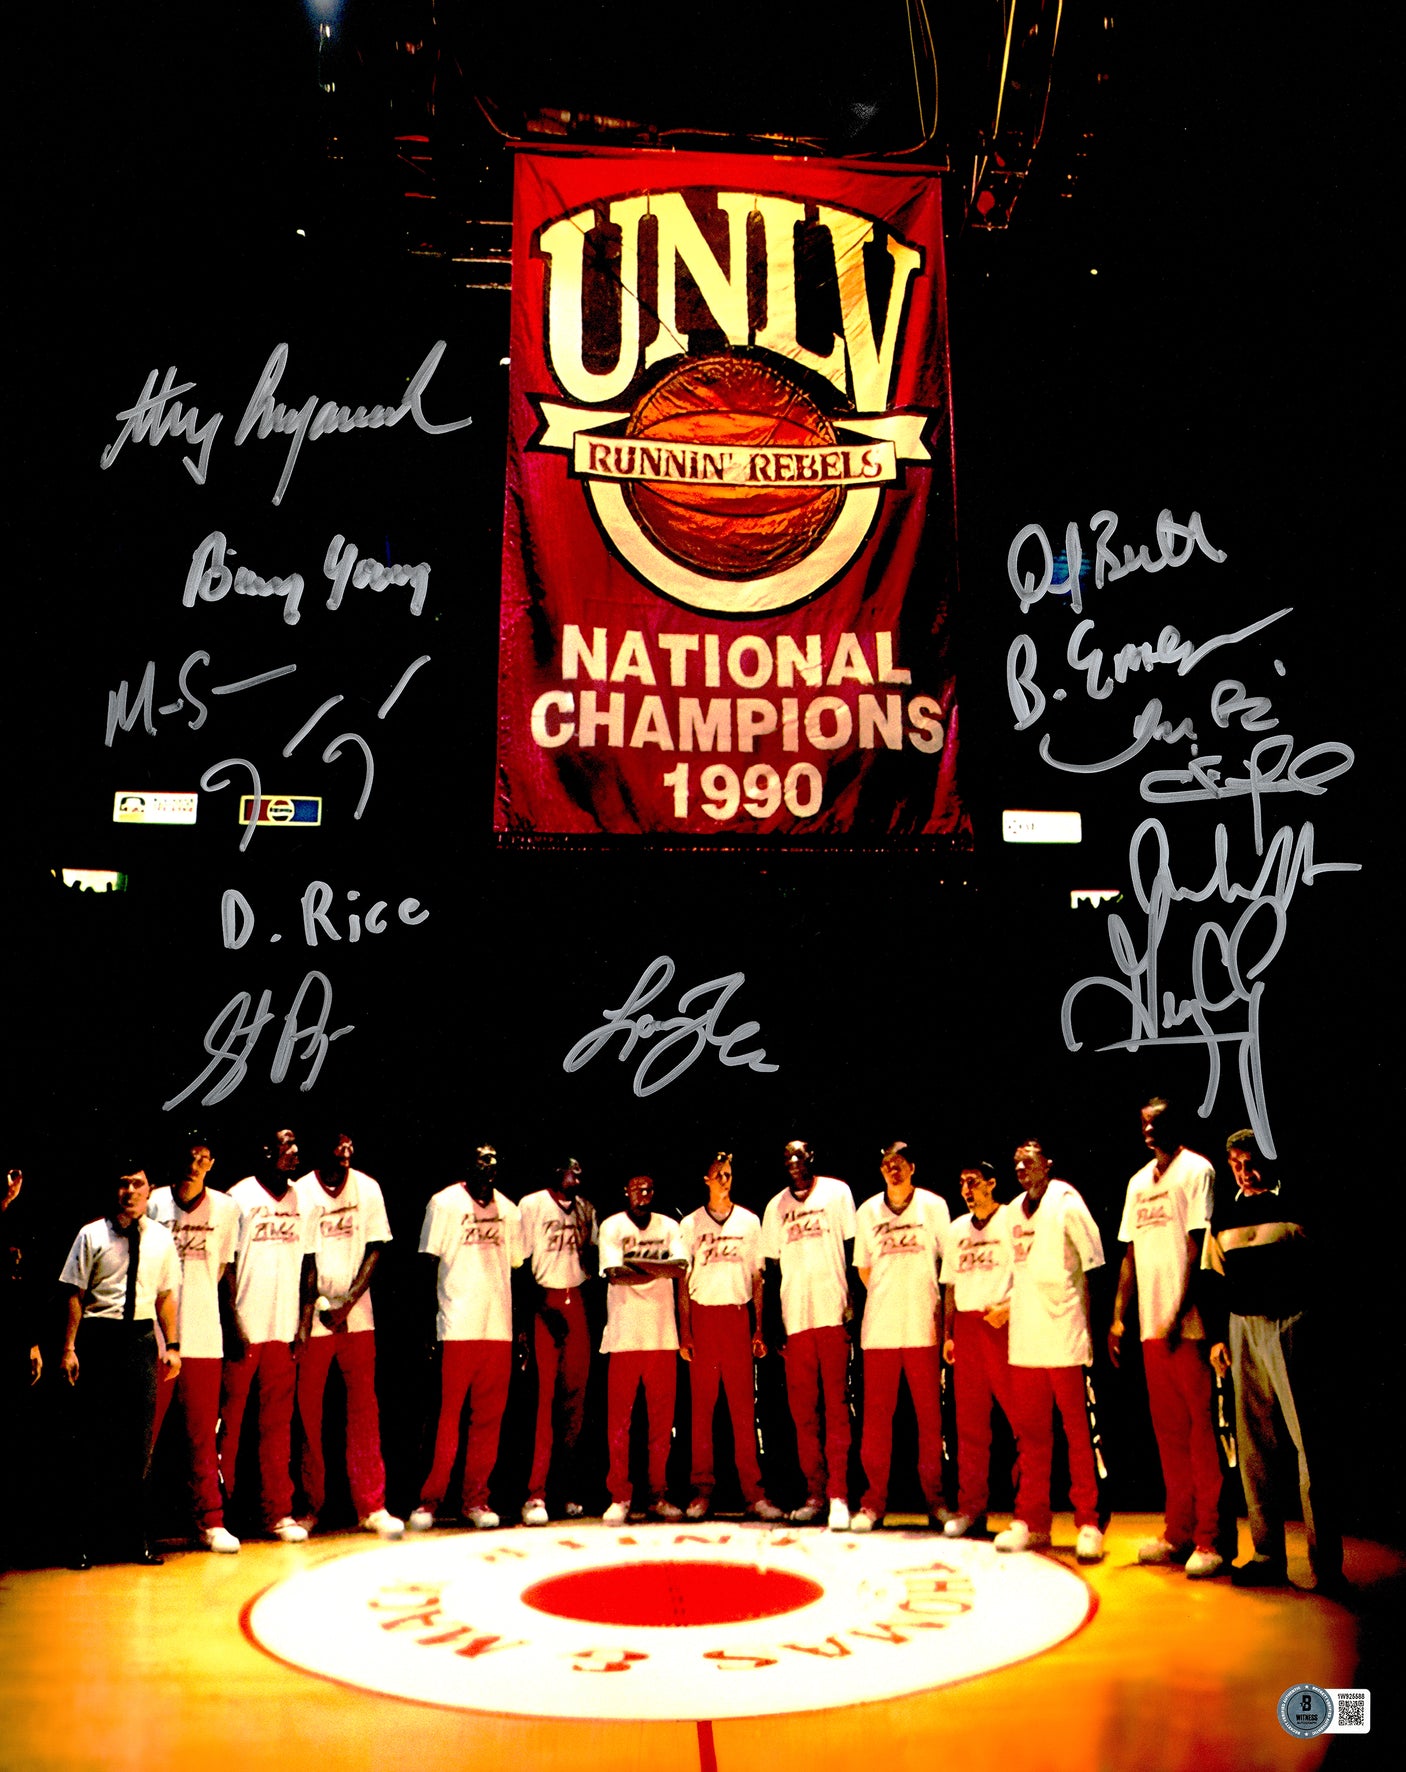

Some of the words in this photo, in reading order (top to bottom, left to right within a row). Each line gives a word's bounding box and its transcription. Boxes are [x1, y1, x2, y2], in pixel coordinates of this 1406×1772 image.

[540, 191, 921, 413] UNLV
[588, 441, 735, 480] RUNNIN'
[748, 450, 884, 482] REBELS
[561, 624, 912, 689] NATIONAL
[530, 690, 945, 755] CHAMPIONS
[663, 762, 823, 821] 1990
[221, 889, 283, 950] D.
[301, 880, 430, 947] Rice
